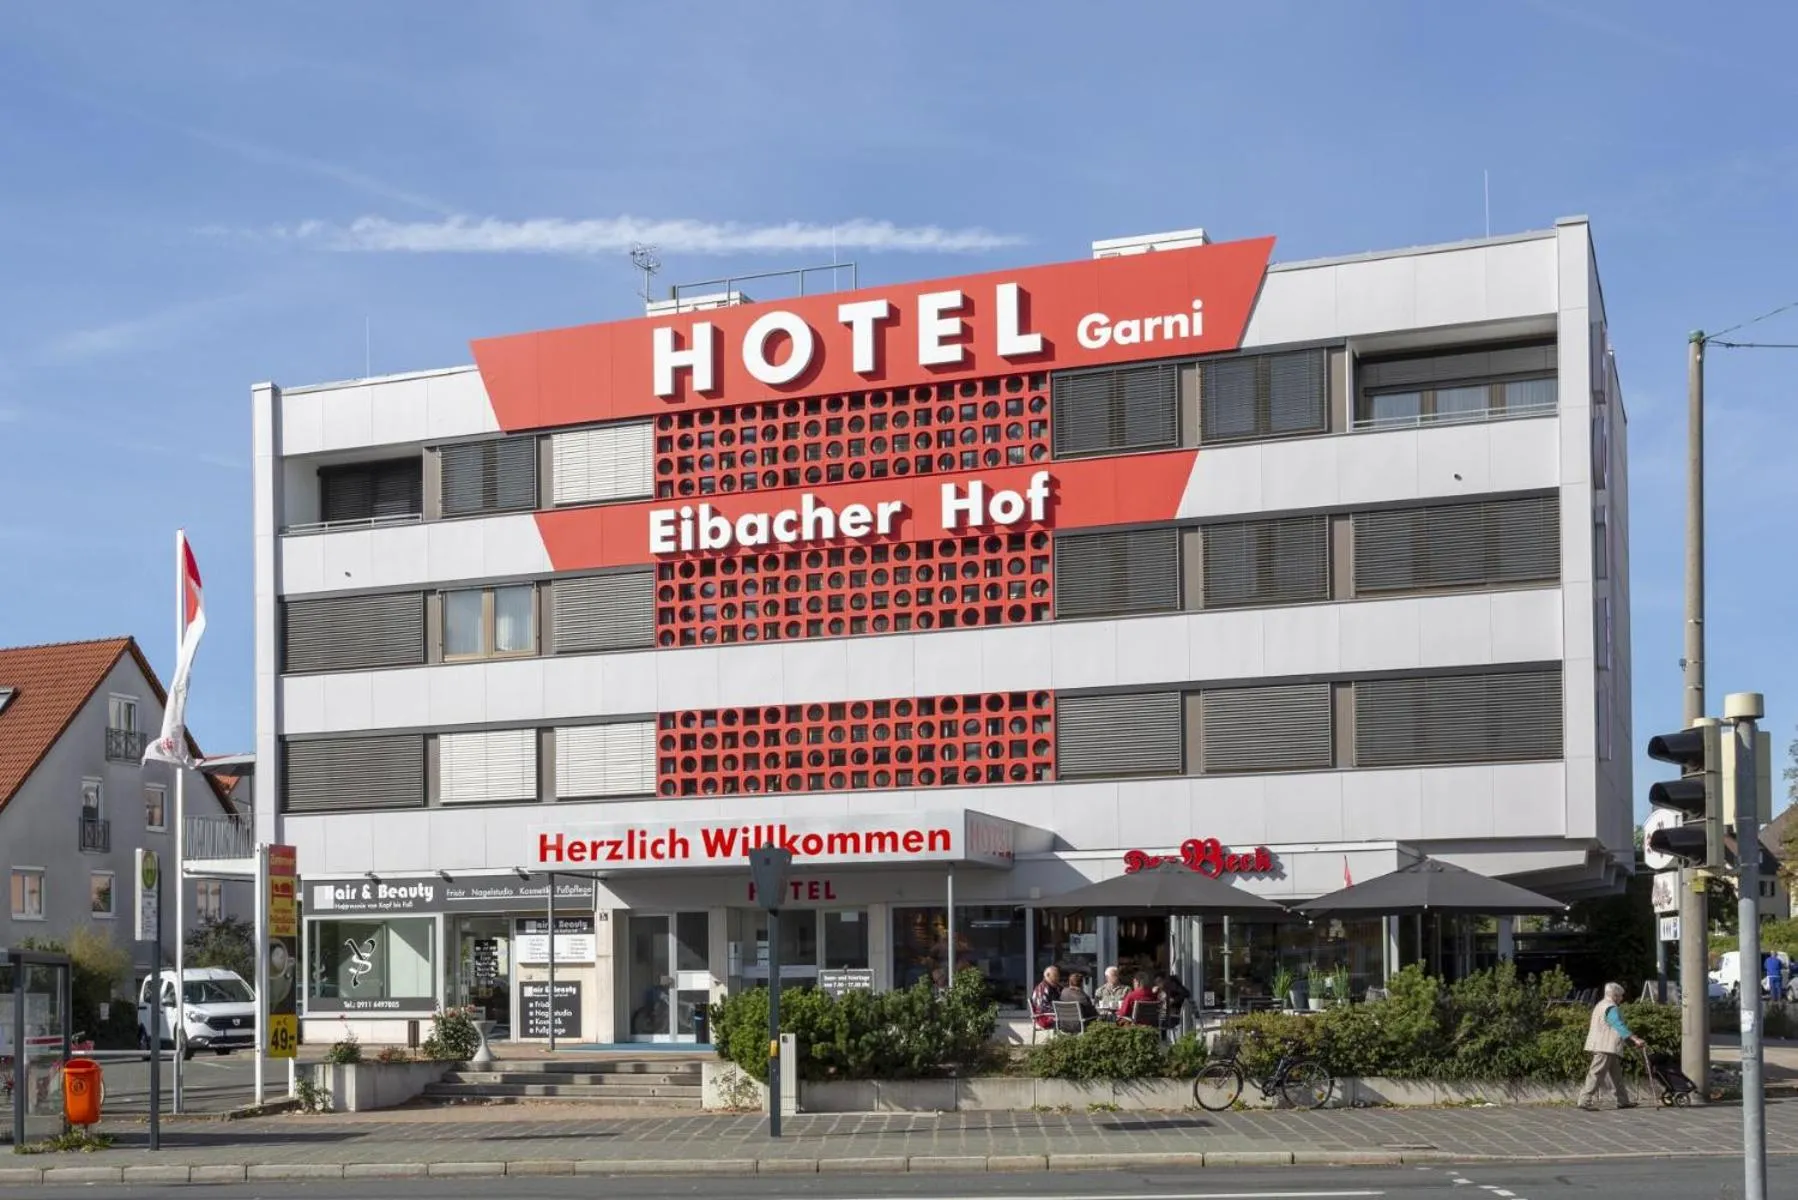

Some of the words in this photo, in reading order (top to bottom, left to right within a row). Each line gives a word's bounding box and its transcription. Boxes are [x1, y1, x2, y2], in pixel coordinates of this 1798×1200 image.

[653, 282, 1043, 397] HOTEL
[1077, 299, 1203, 350] Garni
[650, 493, 902, 554] Eibacher
[941, 471, 1050, 530] Hof
[539, 828, 690, 862] Herzlich
[701, 824, 951, 858] Willkommen
[362, 884, 371, 900] &
[378, 882, 434, 902] Beauty
[749, 880, 836, 901] TEL
